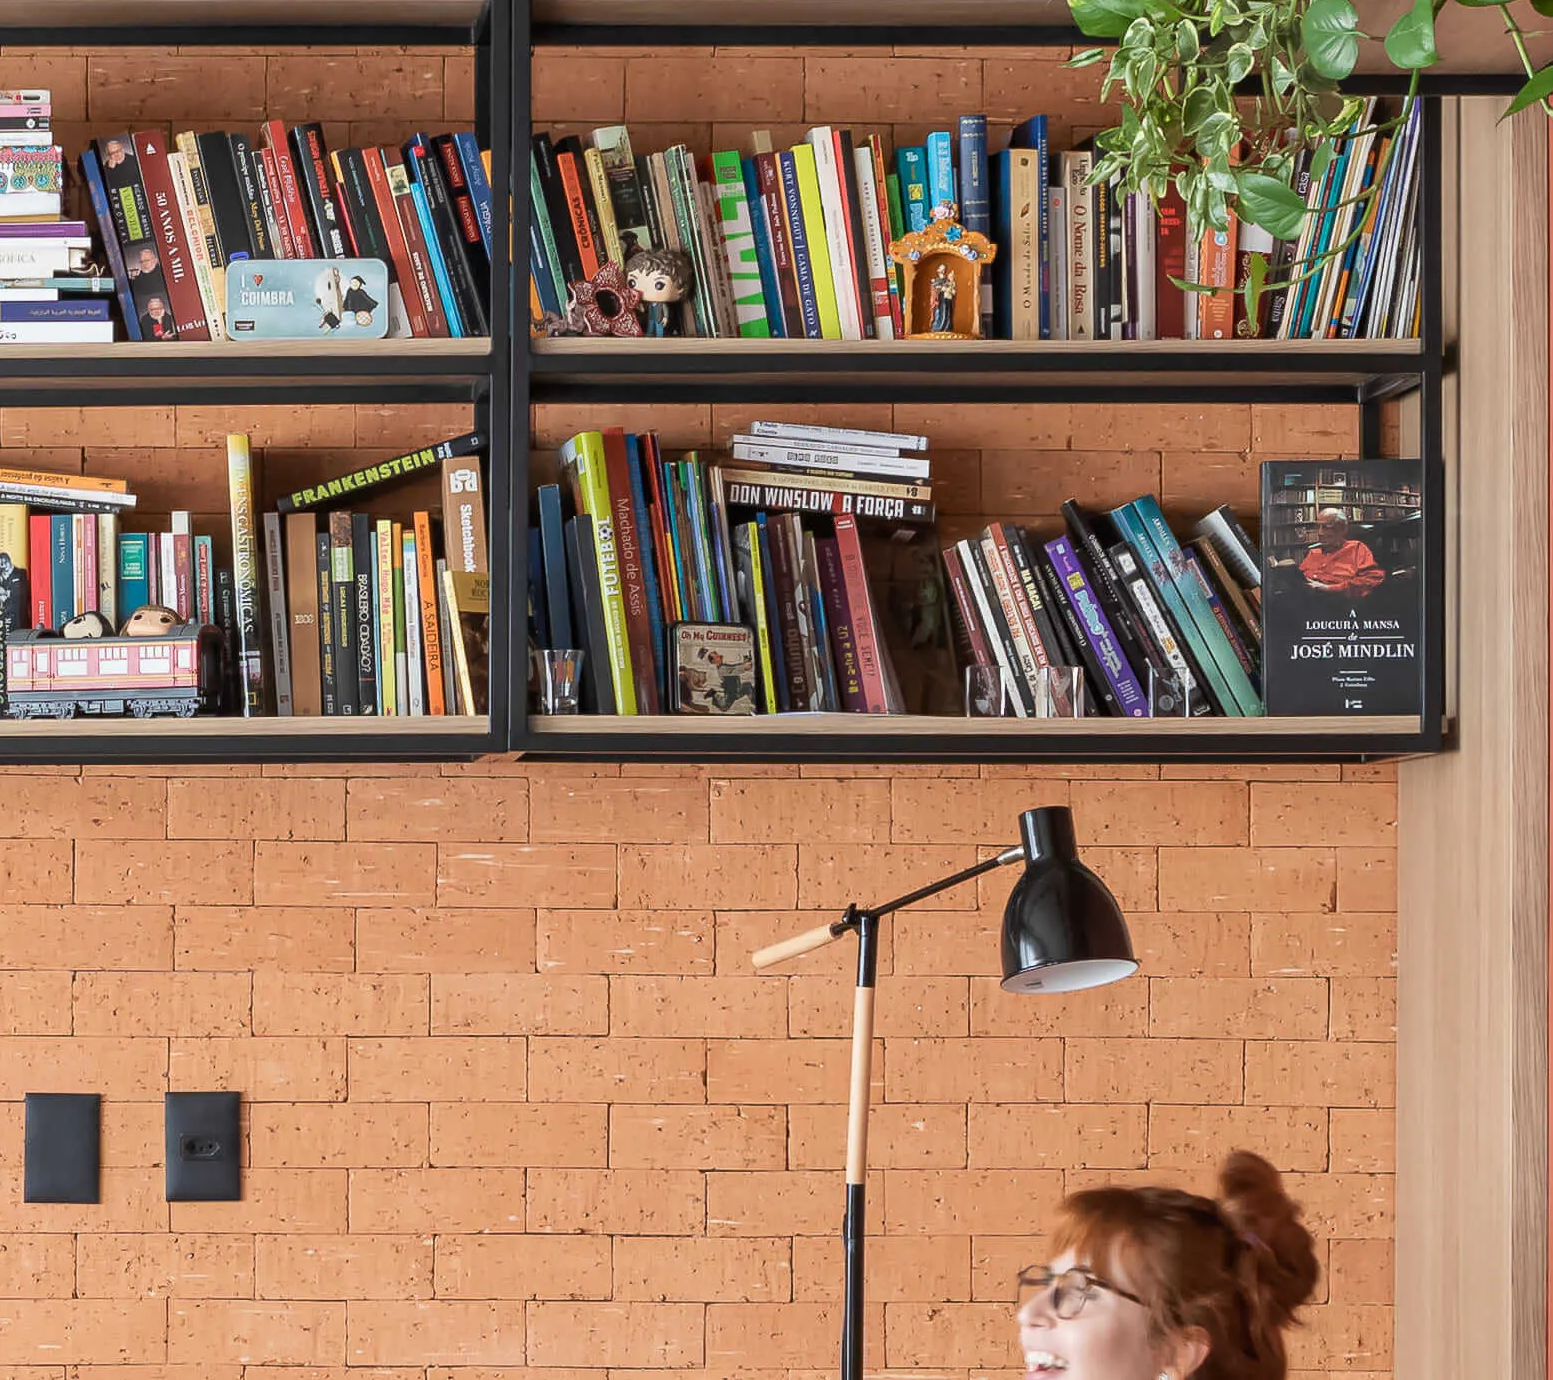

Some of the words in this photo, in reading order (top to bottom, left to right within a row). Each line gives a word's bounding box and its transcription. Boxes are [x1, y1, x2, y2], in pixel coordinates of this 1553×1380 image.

[781, 160, 794, 186] KURT
[151, 190, 169, 209] 50
[1073, 204, 1087, 216] O
[155, 208, 177, 244] ANOS
[573, 195, 590, 249] CRÔNICAS
[786, 187, 803, 241] VONNEGUT
[163, 243, 180, 257] A
[1073, 221, 1087, 256] Nome
[795, 252, 809, 281] CAMA
[1021, 247, 1032, 260] de
[1021, 264, 1032, 295] Mundo
[1073, 261, 1087, 277] da
[240, 290, 295, 306] COIMBRA
[800, 283, 811, 296] DE
[1073, 283, 1087, 314] Rosa
[803, 298, 816, 326] GATO
[1021, 298, 1032, 309] O
[291, 448, 436, 508] FRANKENSTEIN
[730, 484, 762, 504] DON
[764, 488, 834, 512] WINSLOW
[843, 496, 852, 513] A
[856, 498, 905, 520] FORÇA
[460, 503, 477, 573] Sketchbook
[615, 496, 637, 558] Machado
[623, 561, 640, 580] de
[423, 599, 435, 613] A
[626, 581, 644, 616] Assis
[1305, 621, 1360, 631] LOUCURA
[1362, 621, 1400, 630] MANSA
[1348, 608, 1358, 618] A
[424, 613, 440, 671] SAIDEIRA
[1347, 632, 1359, 641] de
[1290, 641, 1334, 660] JOSÉ
[1338, 644, 1417, 659] MINDLIN
